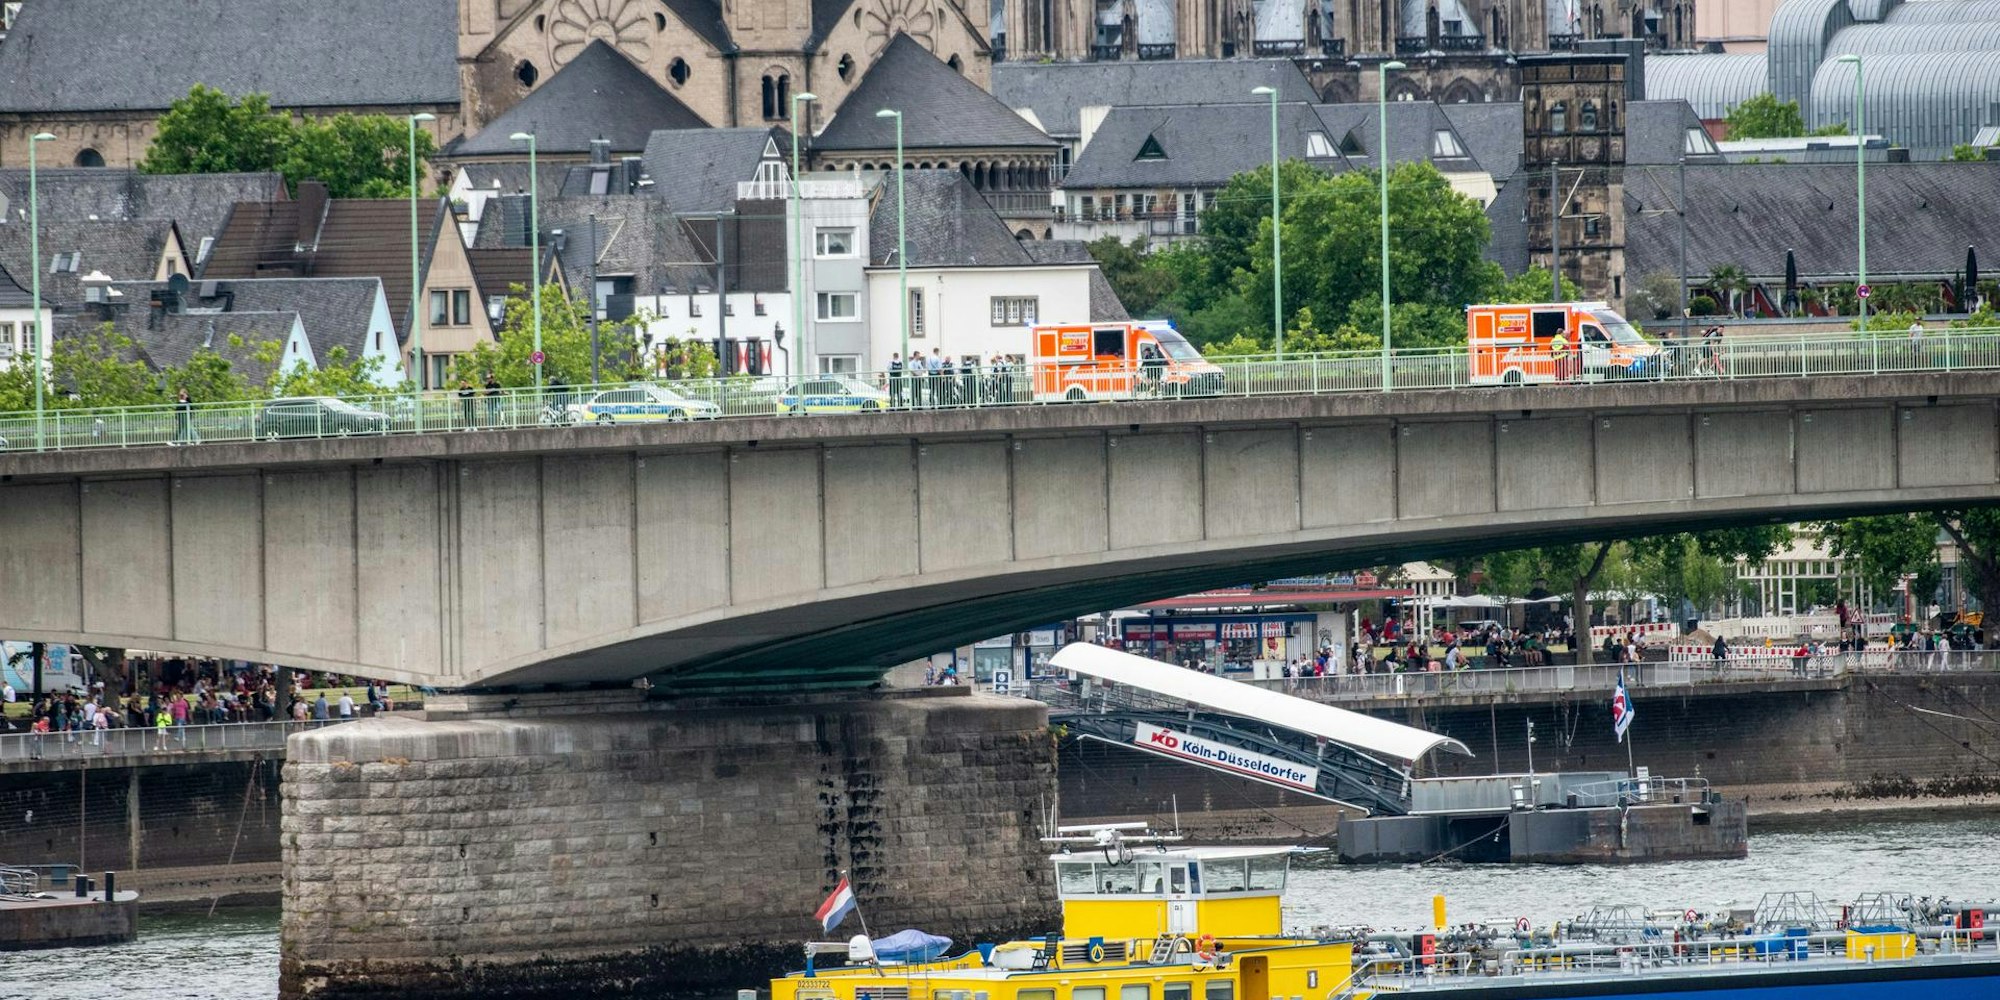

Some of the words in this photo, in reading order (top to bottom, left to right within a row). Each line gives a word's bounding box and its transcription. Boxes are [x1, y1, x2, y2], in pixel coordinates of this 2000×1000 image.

[1151, 728, 1179, 748] KD
[1182, 740, 1306, 783] Köln-Düsseldorfer
[798, 980, 830, 988] 02333722
